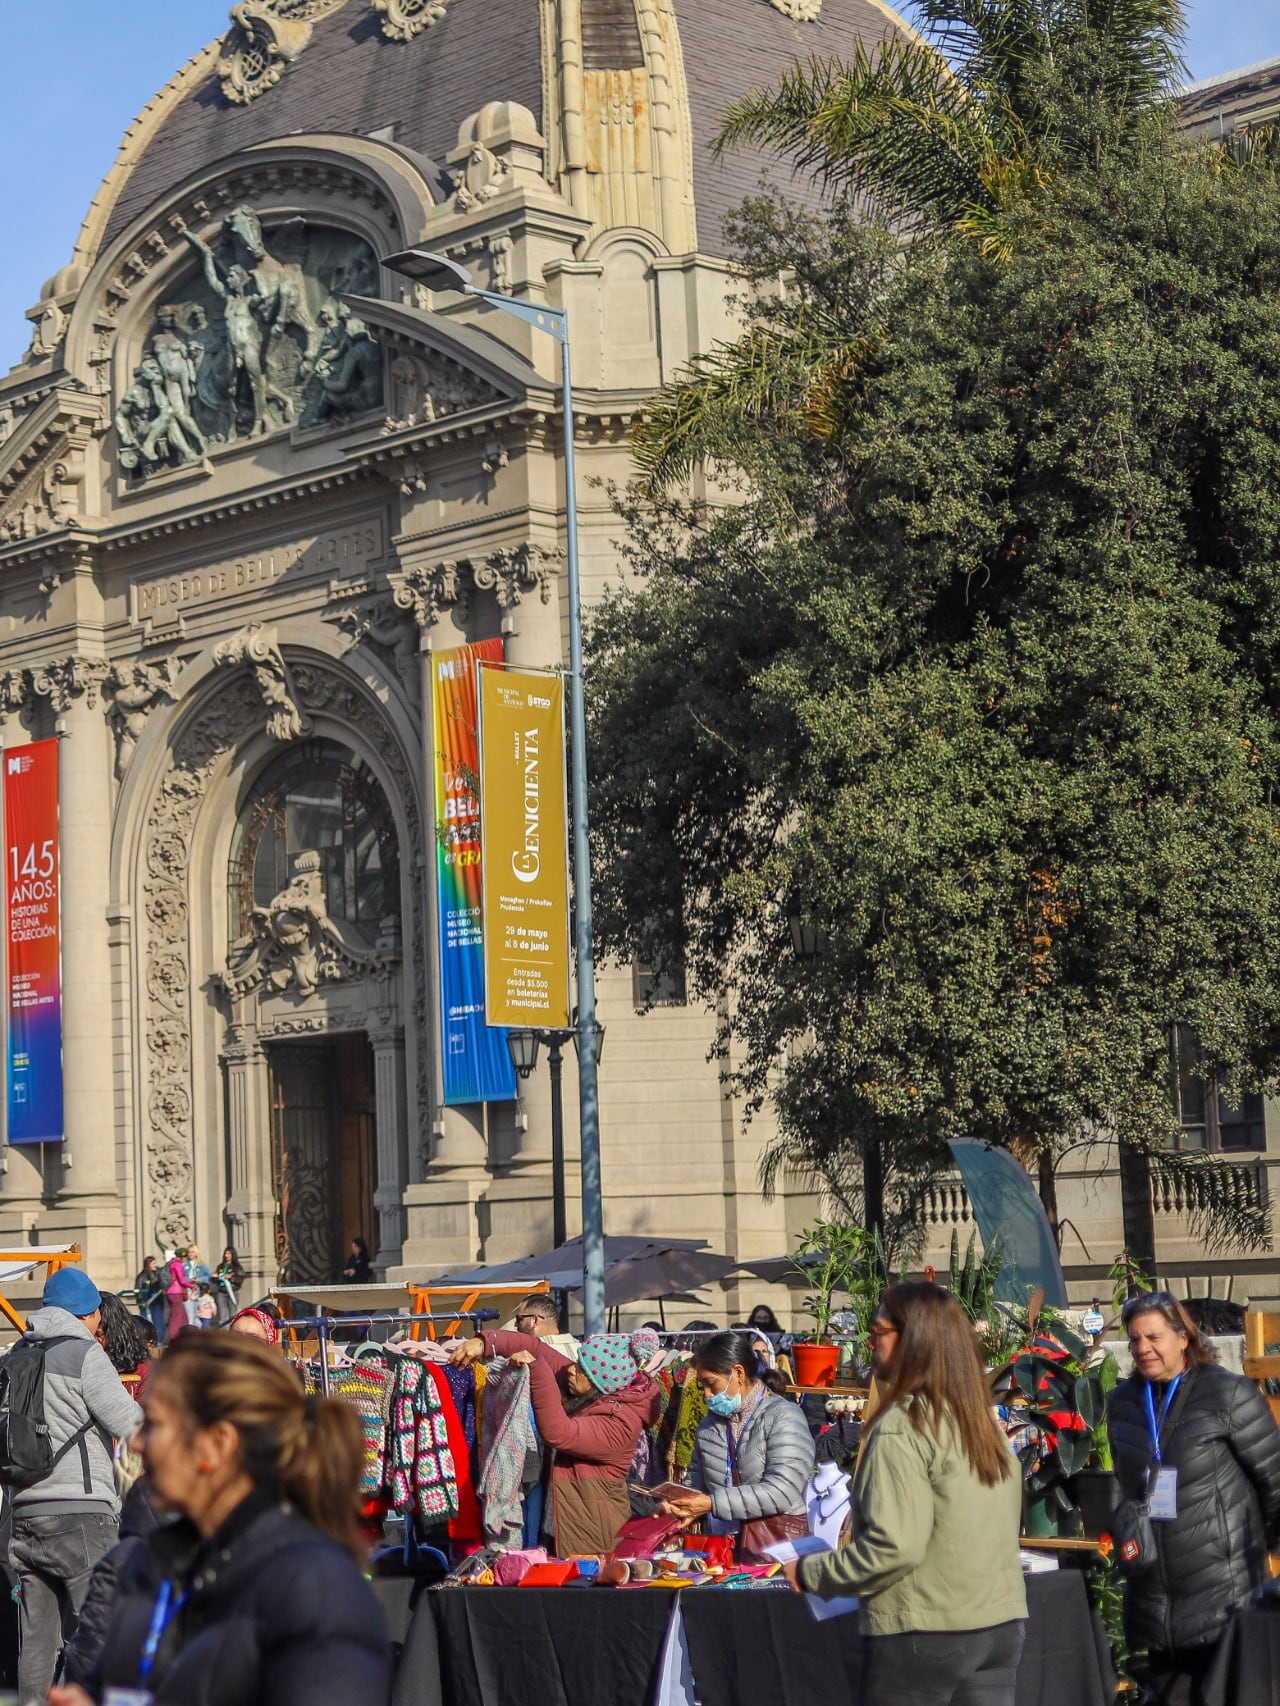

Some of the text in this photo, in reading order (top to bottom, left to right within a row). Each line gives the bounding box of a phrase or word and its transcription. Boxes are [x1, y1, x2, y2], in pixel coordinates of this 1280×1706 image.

[143, 529, 375, 609] MUSEO DE BELLAS ARTES
[511, 728, 540, 883] CENICIENTA
[10, 840, 55, 882] 145
[11, 879, 56, 904] AÑOS:
[11, 902, 48, 918] HISTORIAS
[11, 916, 40, 931] DE UNA
[11, 924, 56, 943] COLECCIÓN
[517, 926, 527, 936] de
[527, 929, 548, 940] mayo
[505, 939, 512, 948] al
[520, 940, 529, 949] de
[529, 940, 550, 952] junio
[513, 968, 542, 978] Entradas
[506, 977, 526, 987] desde
